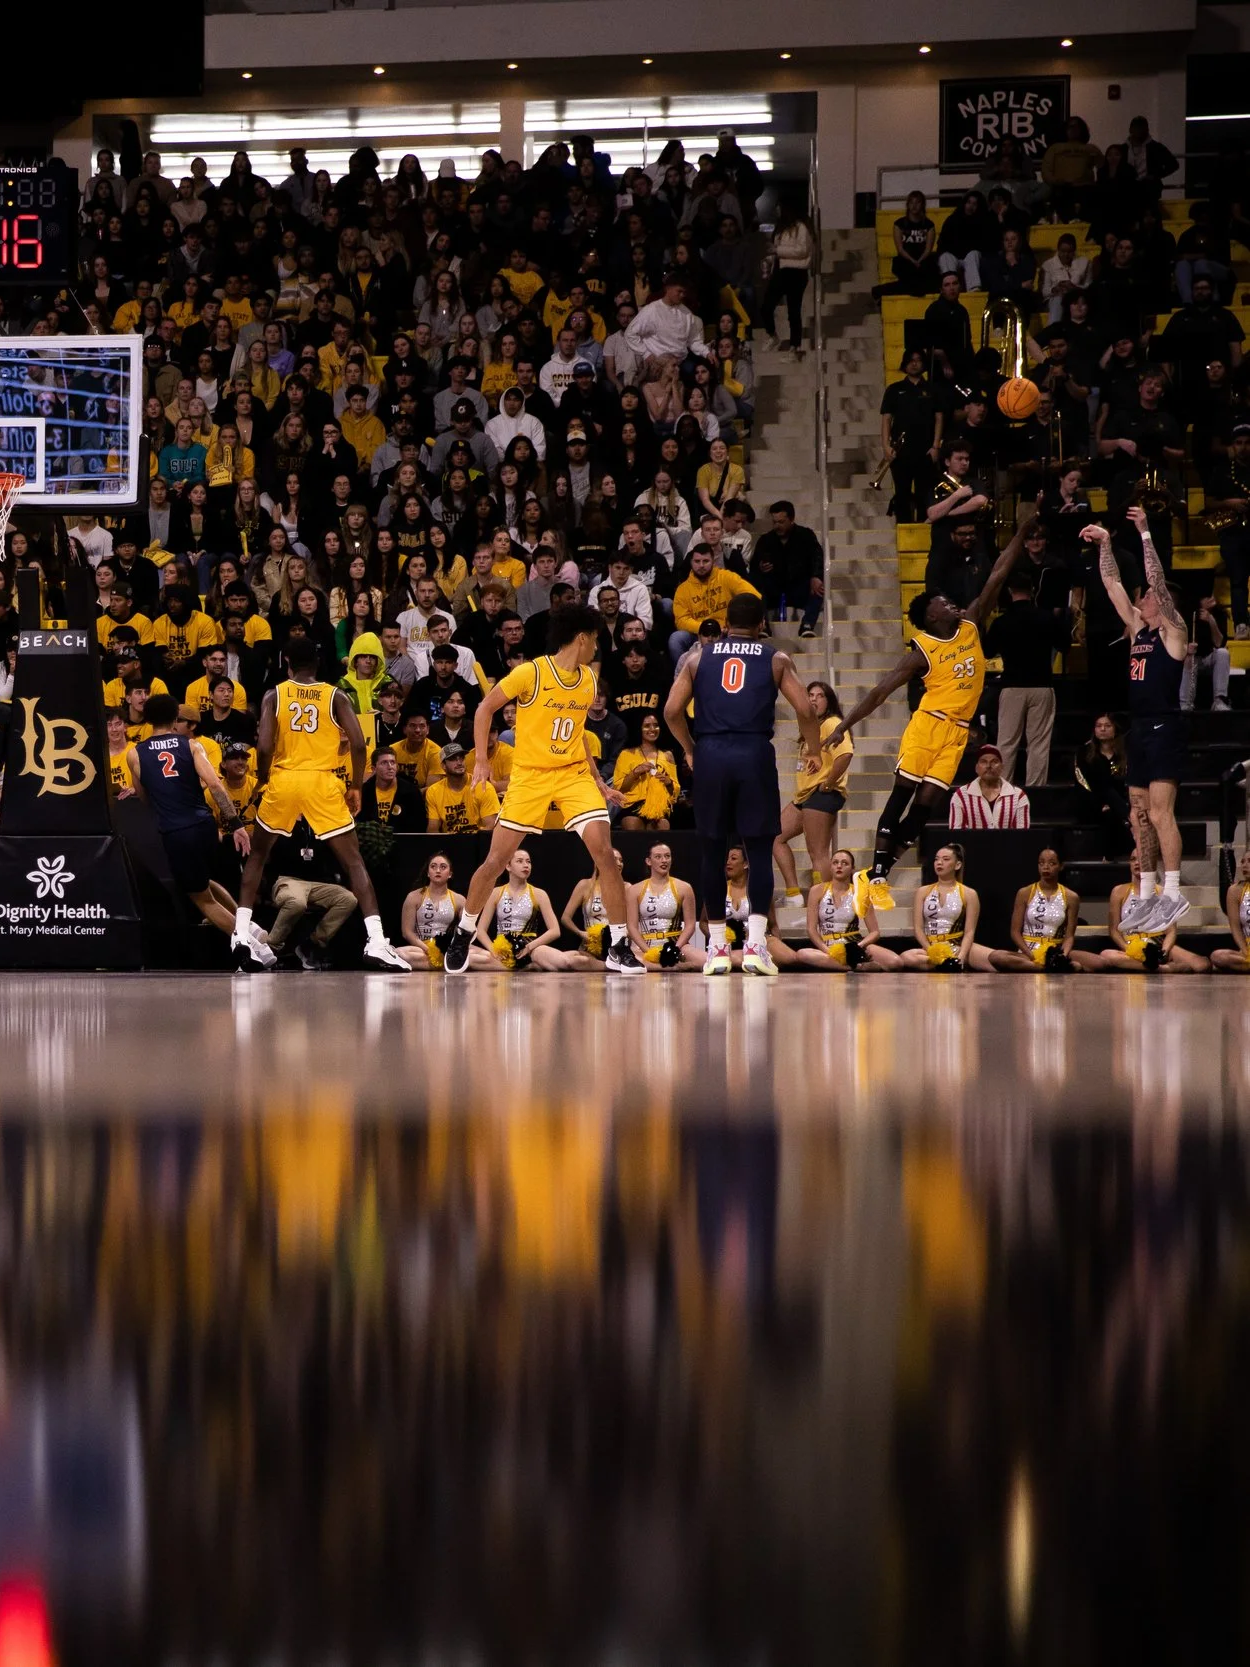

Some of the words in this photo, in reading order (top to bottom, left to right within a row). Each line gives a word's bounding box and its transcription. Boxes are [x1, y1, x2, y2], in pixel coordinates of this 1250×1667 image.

[957, 91, 1052, 119] NAPLES
[976, 111, 1035, 139] RIB
[959, 134, 1047, 159] COMNY
[0, 214, 44, 269] 16
[19, 634, 87, 649] BEACH
[169, 635, 185, 643] THIS
[178, 641, 190, 649] MY
[411, 626, 430, 643] GA
[712, 642, 763, 656] HARRIS
[721, 657, 746, 694] 0
[952, 655, 976, 679] 25
[1130, 657, 1147, 681] 21
[296, 687, 323, 701] TRAORE
[544, 698, 565, 712] Long
[567, 700, 589, 711] Beach
[289, 701, 319, 734] 23
[550, 717, 575, 743] 10
[17, 696, 98, 798] LB
[148, 737, 179, 751] JONES
[157, 751, 180, 778] 2
[113, 773, 125, 782] MY
[444, 803, 466, 813] THIS
[593, 897, 602, 921] ACH
[647, 896, 658, 933] BEACH
[927, 894, 939, 936] BEACH
[1034, 896, 1046, 938] BEACH
[9, 925, 34, 938] Mary
[35, 925, 72, 935] Medical
[73, 926, 106, 935] Center
